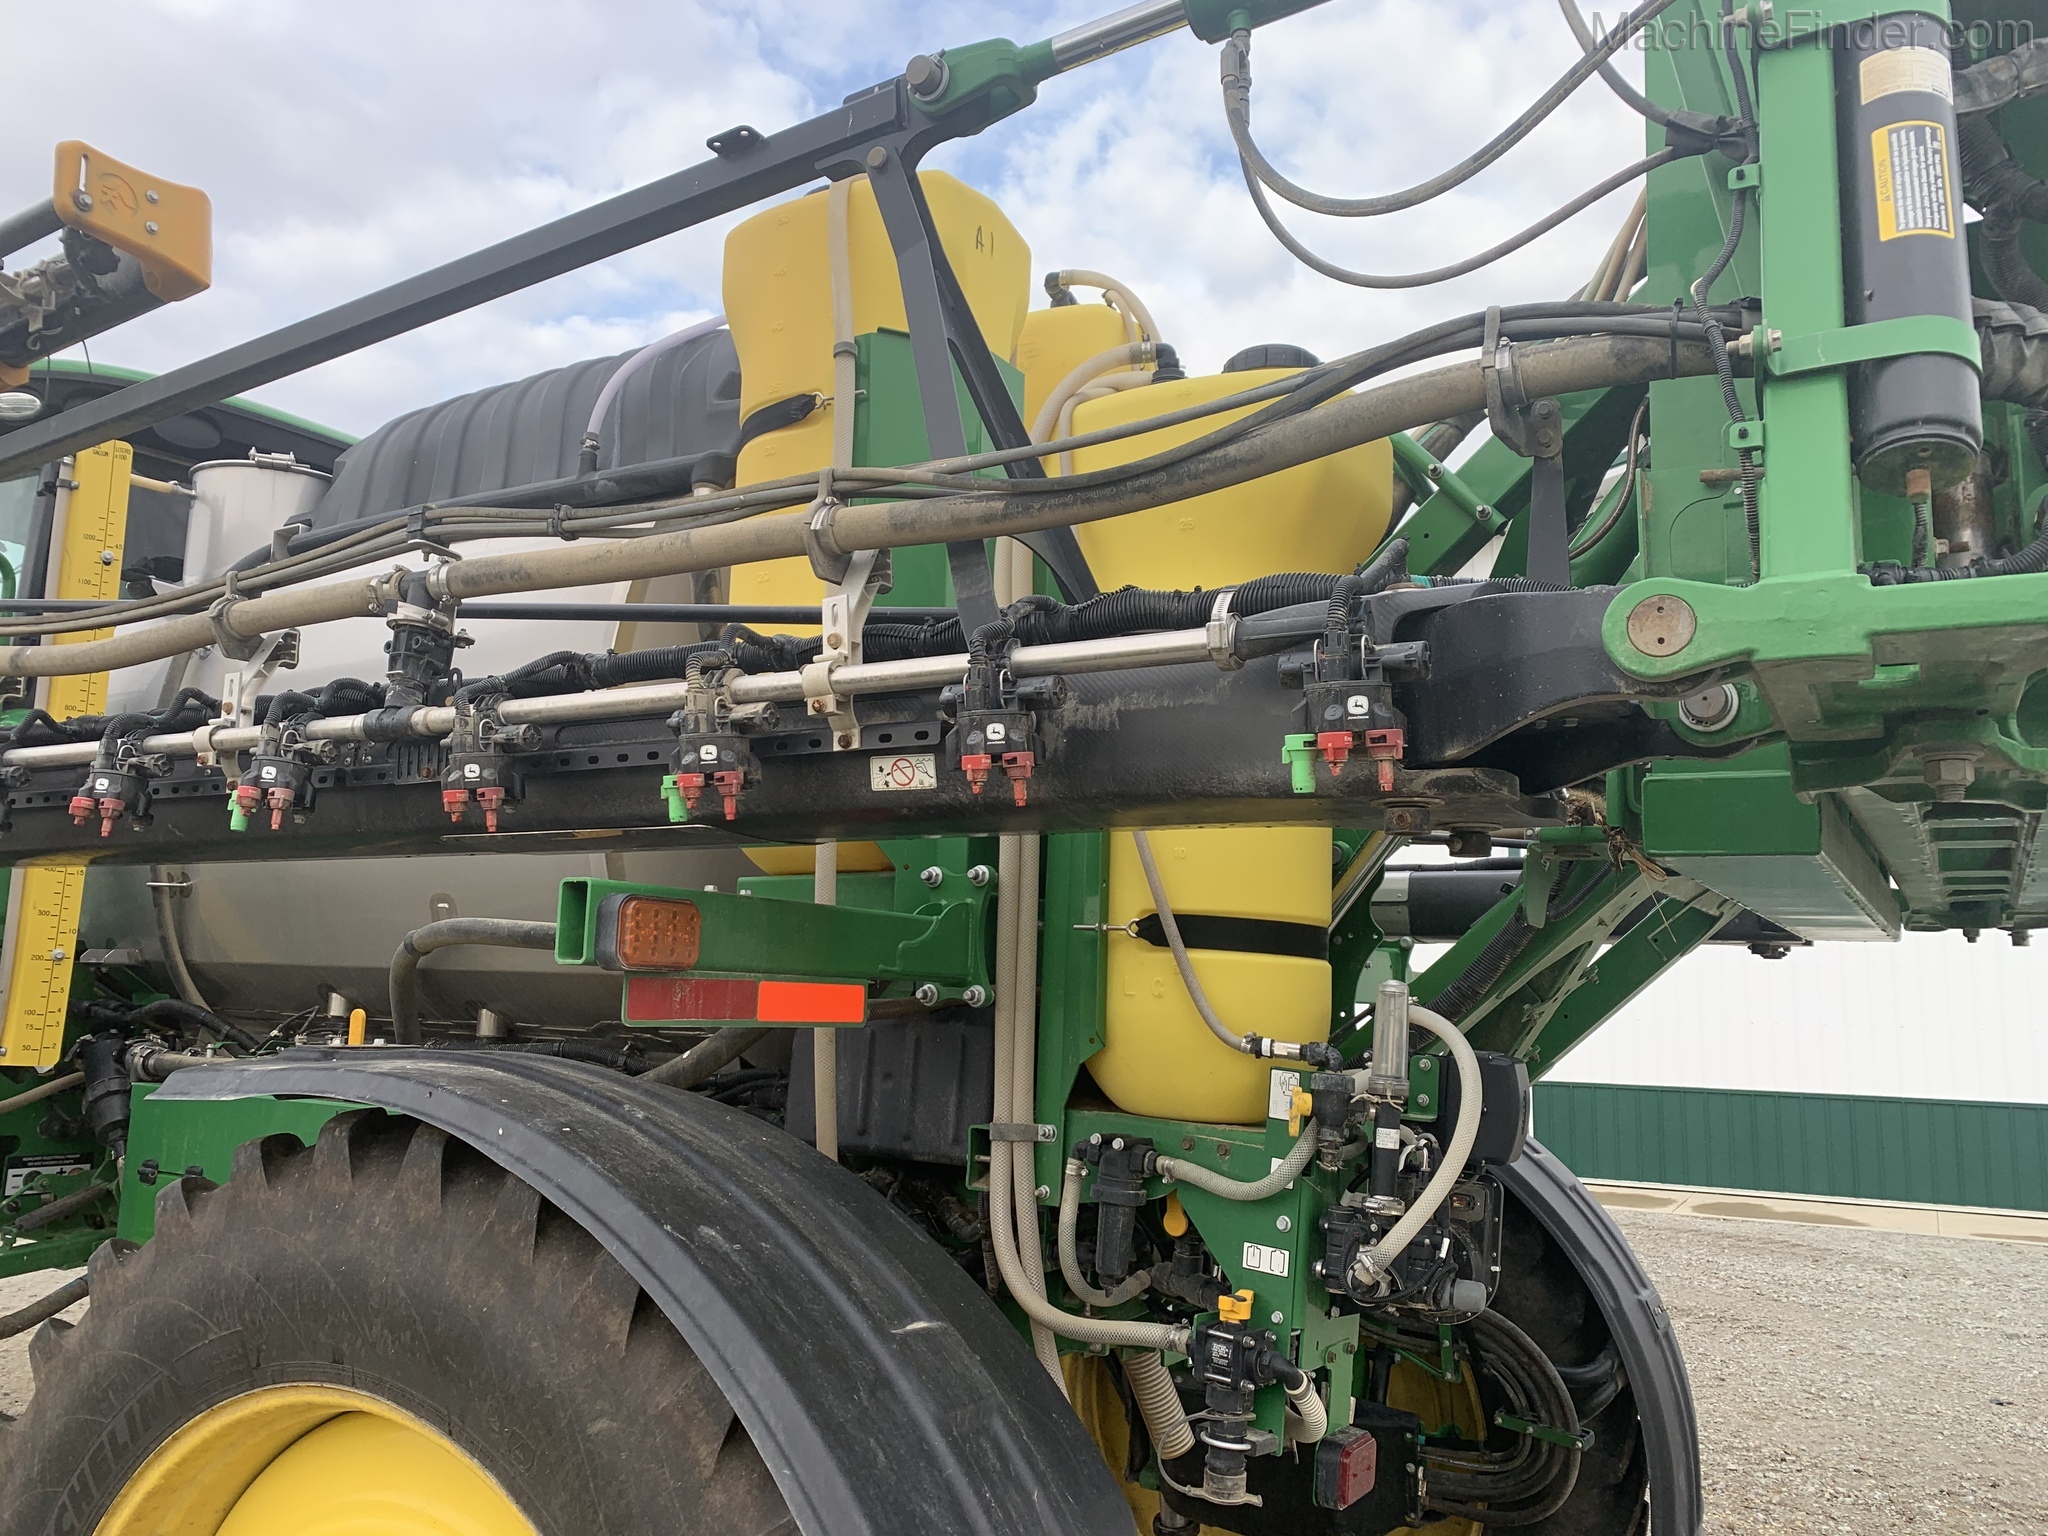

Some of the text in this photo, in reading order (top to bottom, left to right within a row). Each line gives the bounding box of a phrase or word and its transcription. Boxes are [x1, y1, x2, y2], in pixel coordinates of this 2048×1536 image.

[1877, 159, 1889, 195] CAUTION
[1179, 518, 1195, 530] 25
[83, 533, 96, 541] 1200
[757, 571, 770, 583] 20
[64, 704, 77, 712] 800
[1174, 847, 1187, 859] 10
[37, 909, 50, 917] 300
[50, 1373, 174, 1536] CHELIN
